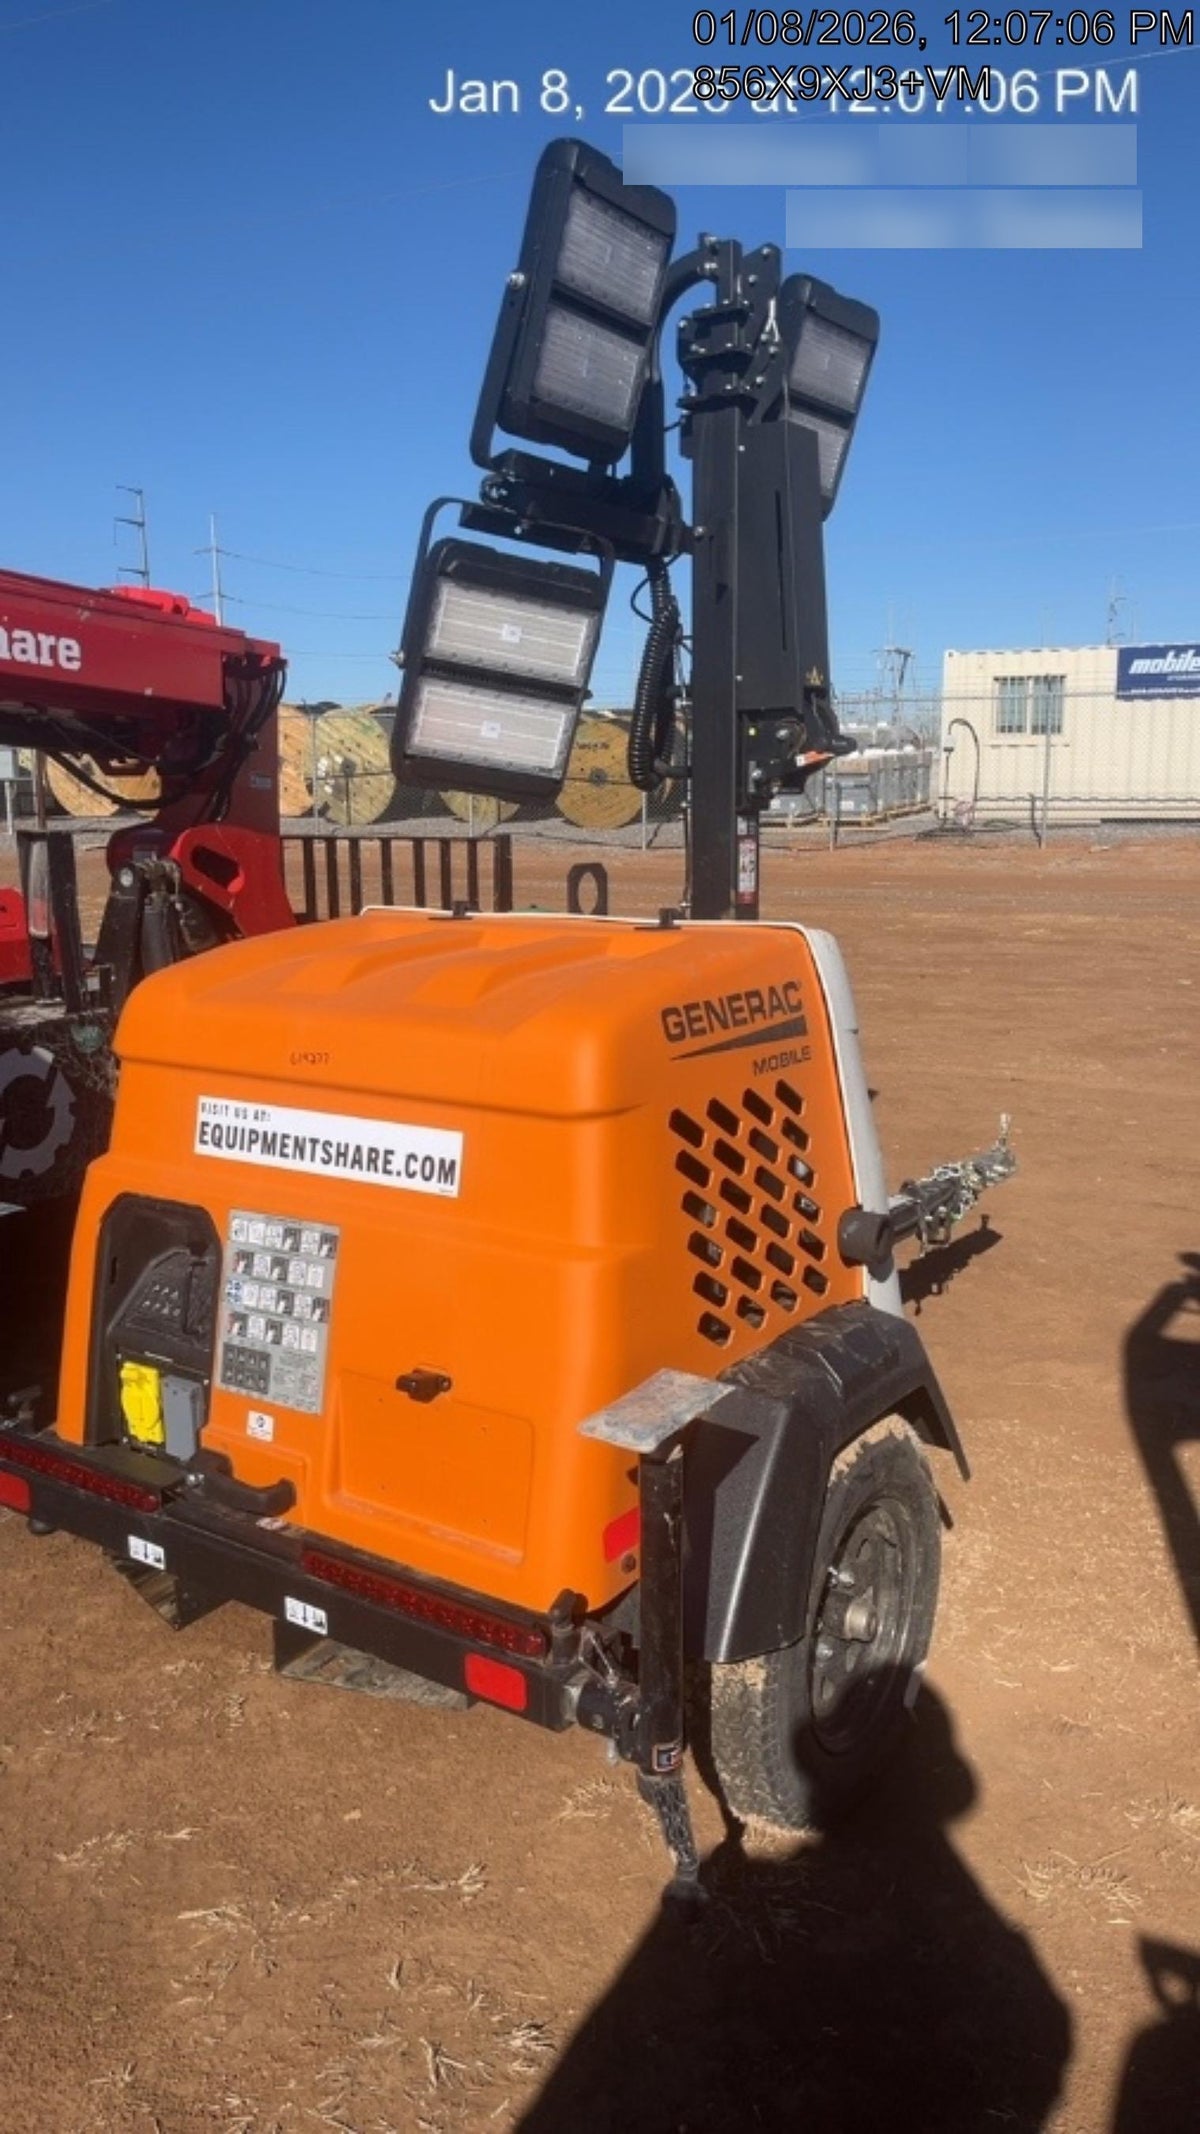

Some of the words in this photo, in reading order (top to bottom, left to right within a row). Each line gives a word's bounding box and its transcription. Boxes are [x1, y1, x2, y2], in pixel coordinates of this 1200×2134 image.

[1128, 649, 1200, 674] mobile
[661, 981, 803, 1043] GENERAC
[753, 1046, 812, 1076] MOBILE
[200, 1102, 229, 1117] VISIT
[234, 1106, 248, 1120] US
[198, 1120, 457, 1186] EQUIPMENTSHARE.COM
